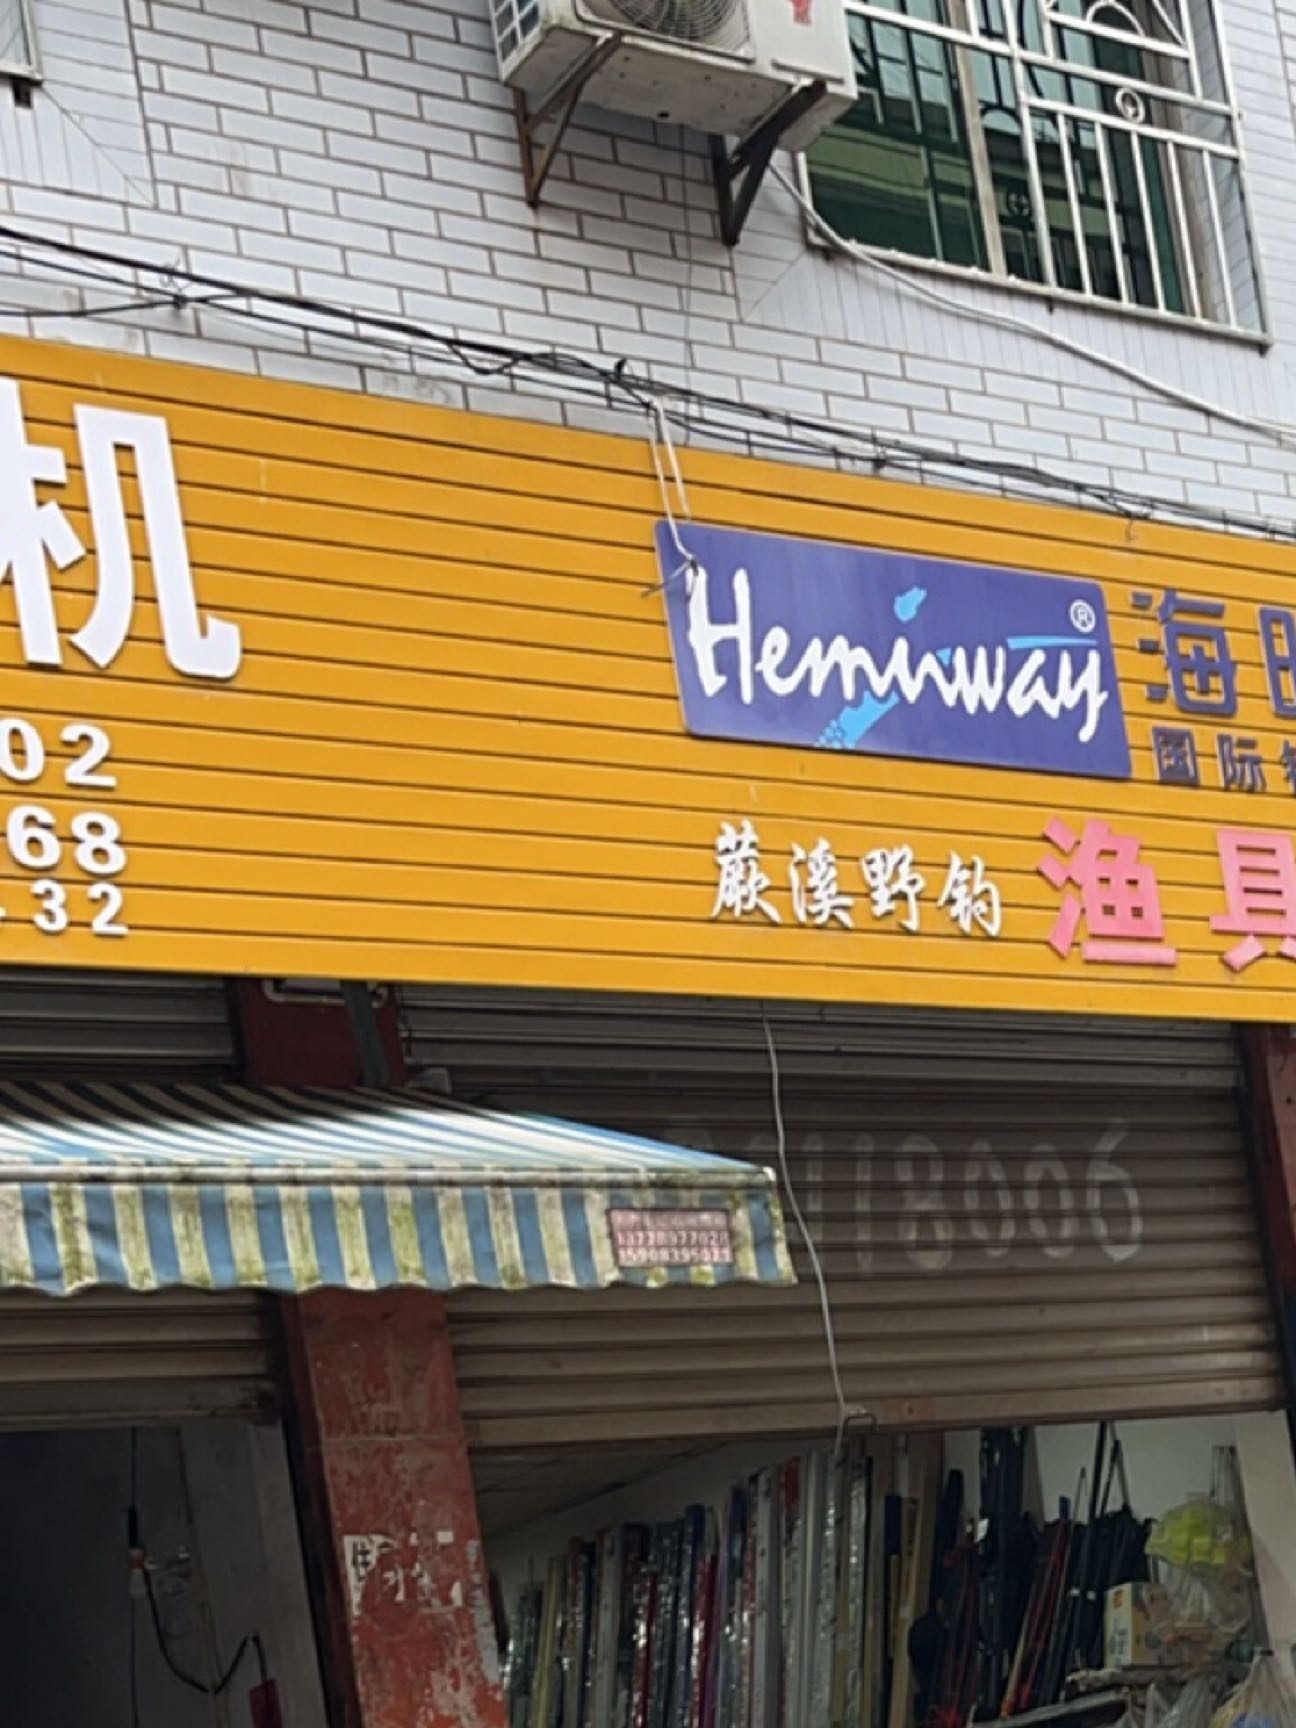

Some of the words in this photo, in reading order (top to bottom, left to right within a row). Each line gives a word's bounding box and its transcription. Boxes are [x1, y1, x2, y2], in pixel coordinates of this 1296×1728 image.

[0, 376, 242, 680] 机
[6, 805, 127, 876] 68
[0, 878, 129, 936] 32
